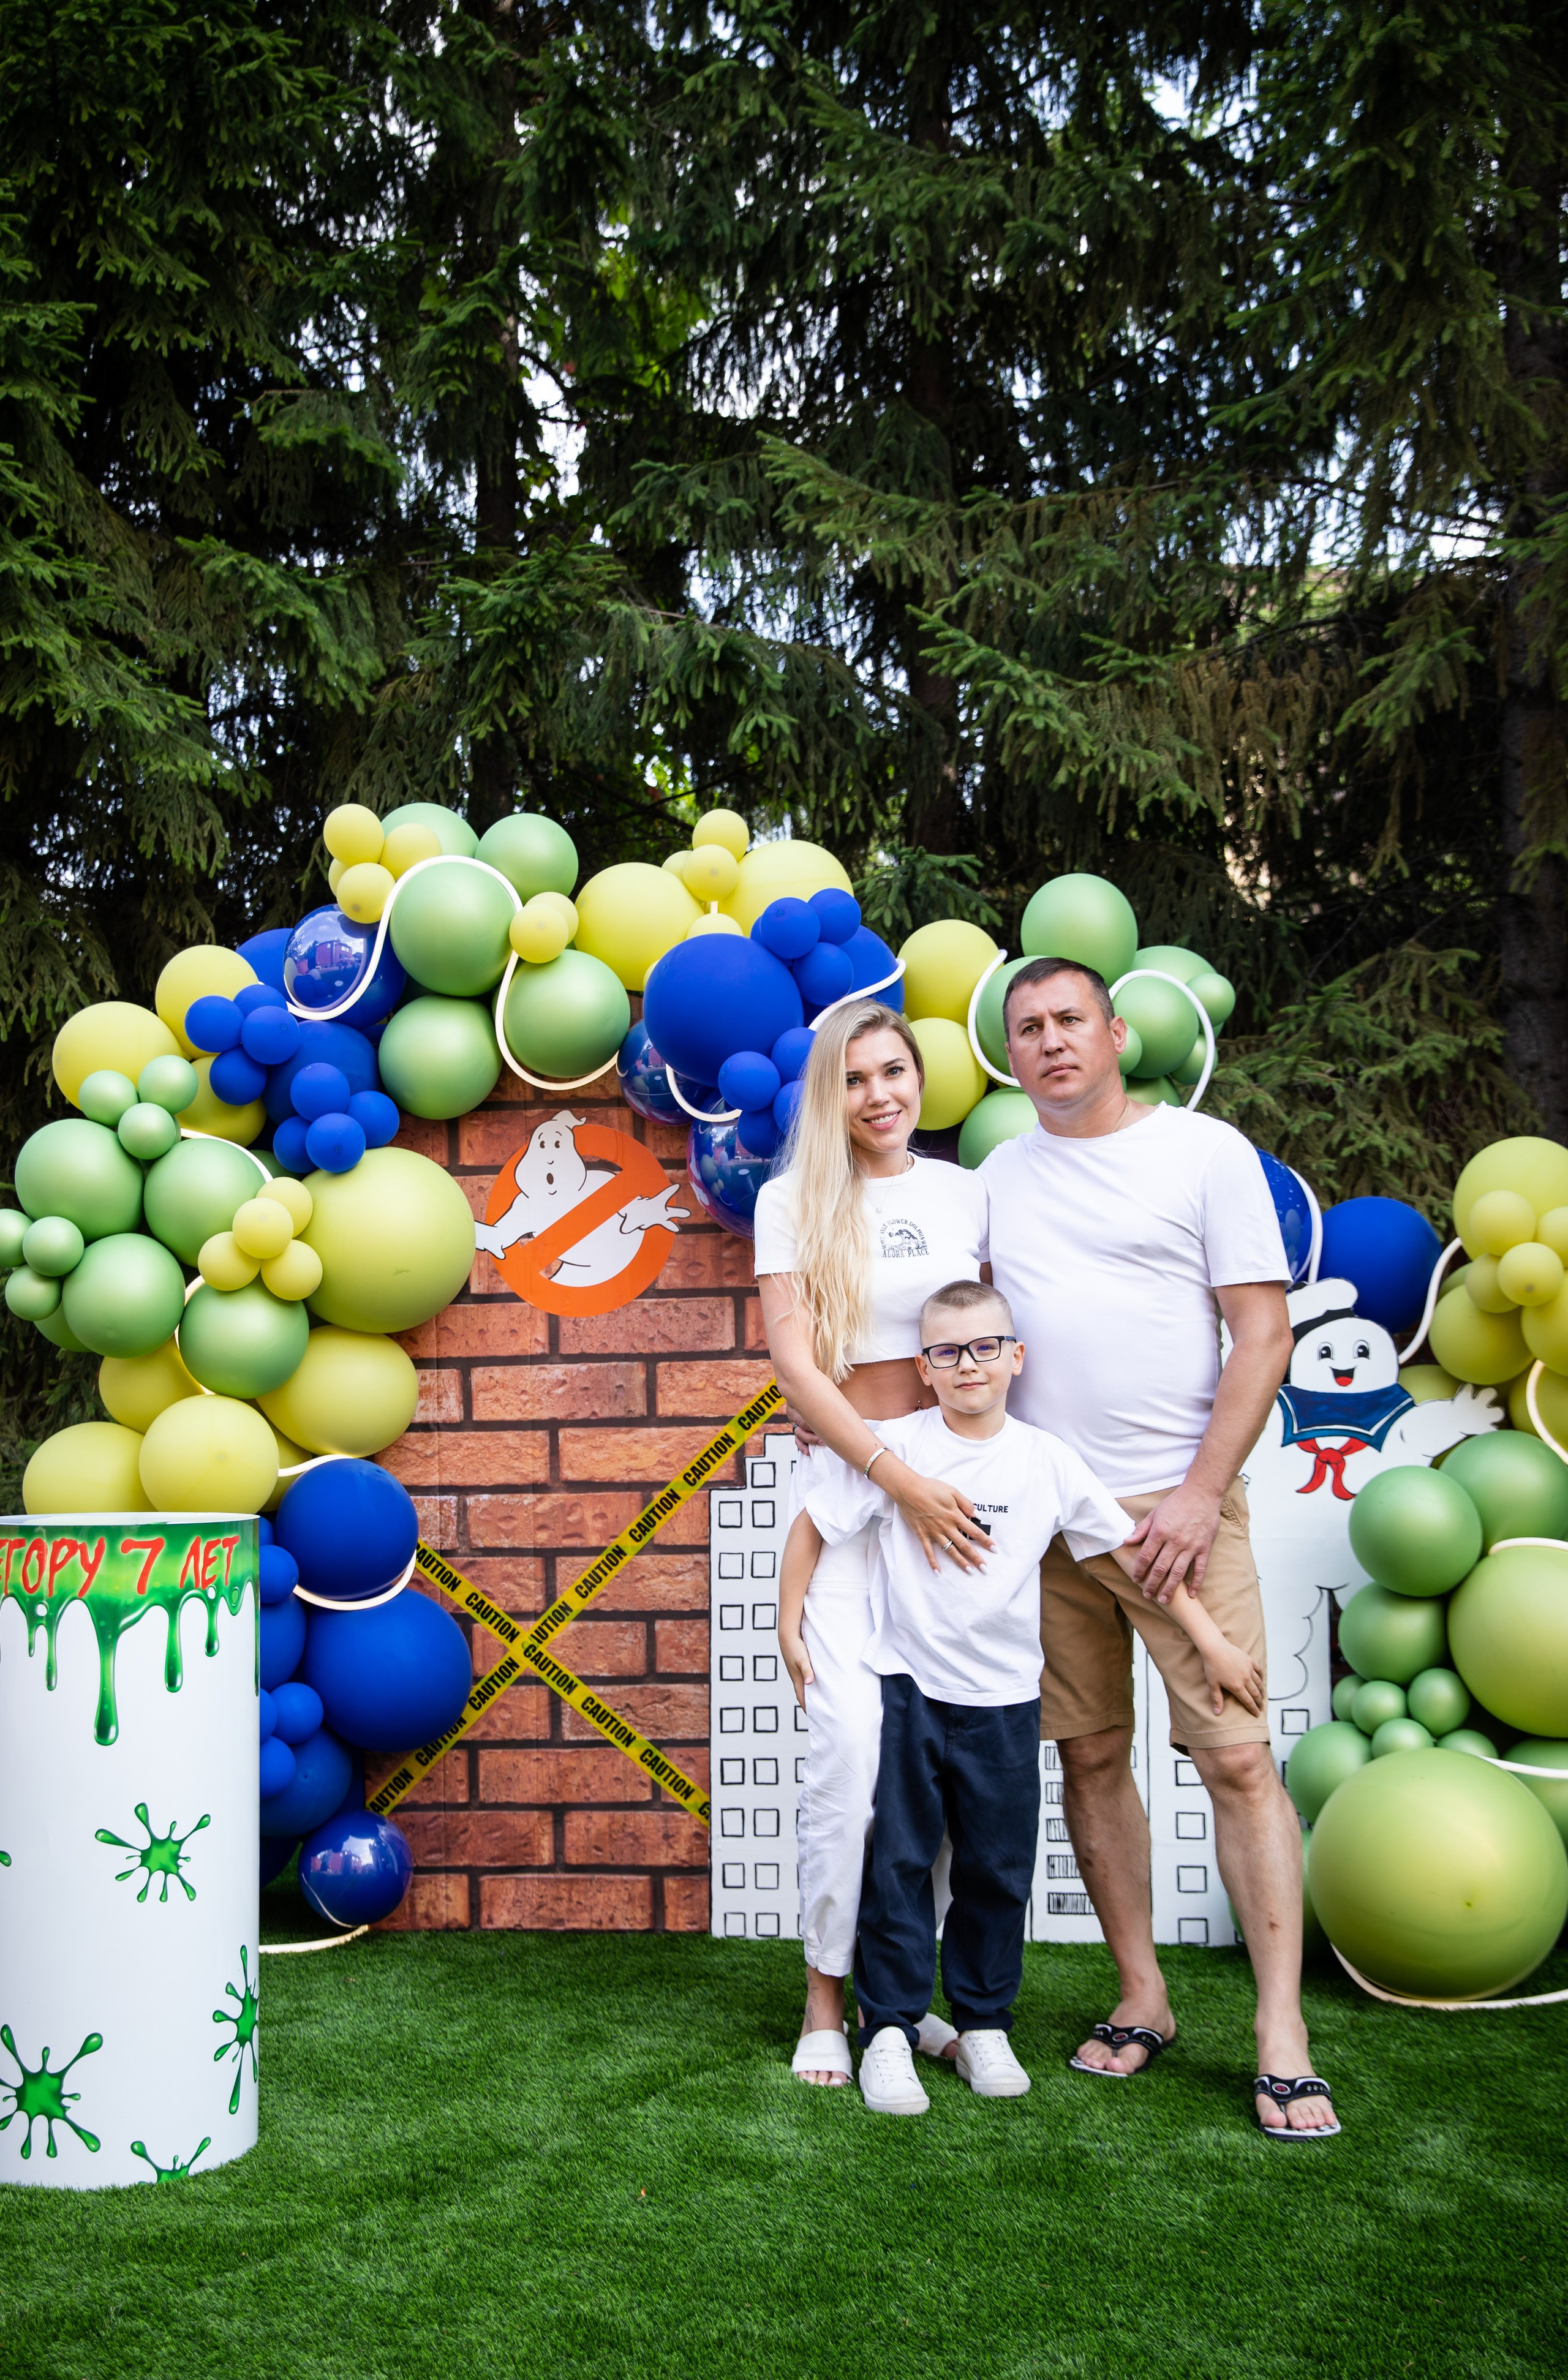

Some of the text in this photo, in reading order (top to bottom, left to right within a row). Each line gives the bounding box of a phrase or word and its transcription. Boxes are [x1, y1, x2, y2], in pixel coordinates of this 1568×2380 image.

[907, 1248, 930, 1257] PLACE
[121, 1537, 165, 1595] 7
[179, 1535, 240, 1590] ЛЕТ
[369, 1768, 415, 1814] AUTION
[467, 1656, 520, 1711] CAUTION
[575, 1544, 628, 1599] CAUTION
[628, 1488, 682, 1543] CAUTION
[682, 1433, 736, 1487] CAUTION
[737, 1384, 782, 1431] CAUTIO
[417, 1542, 695, 1801] AUTION CAUTION CAUTION CAUTION CAUTION
